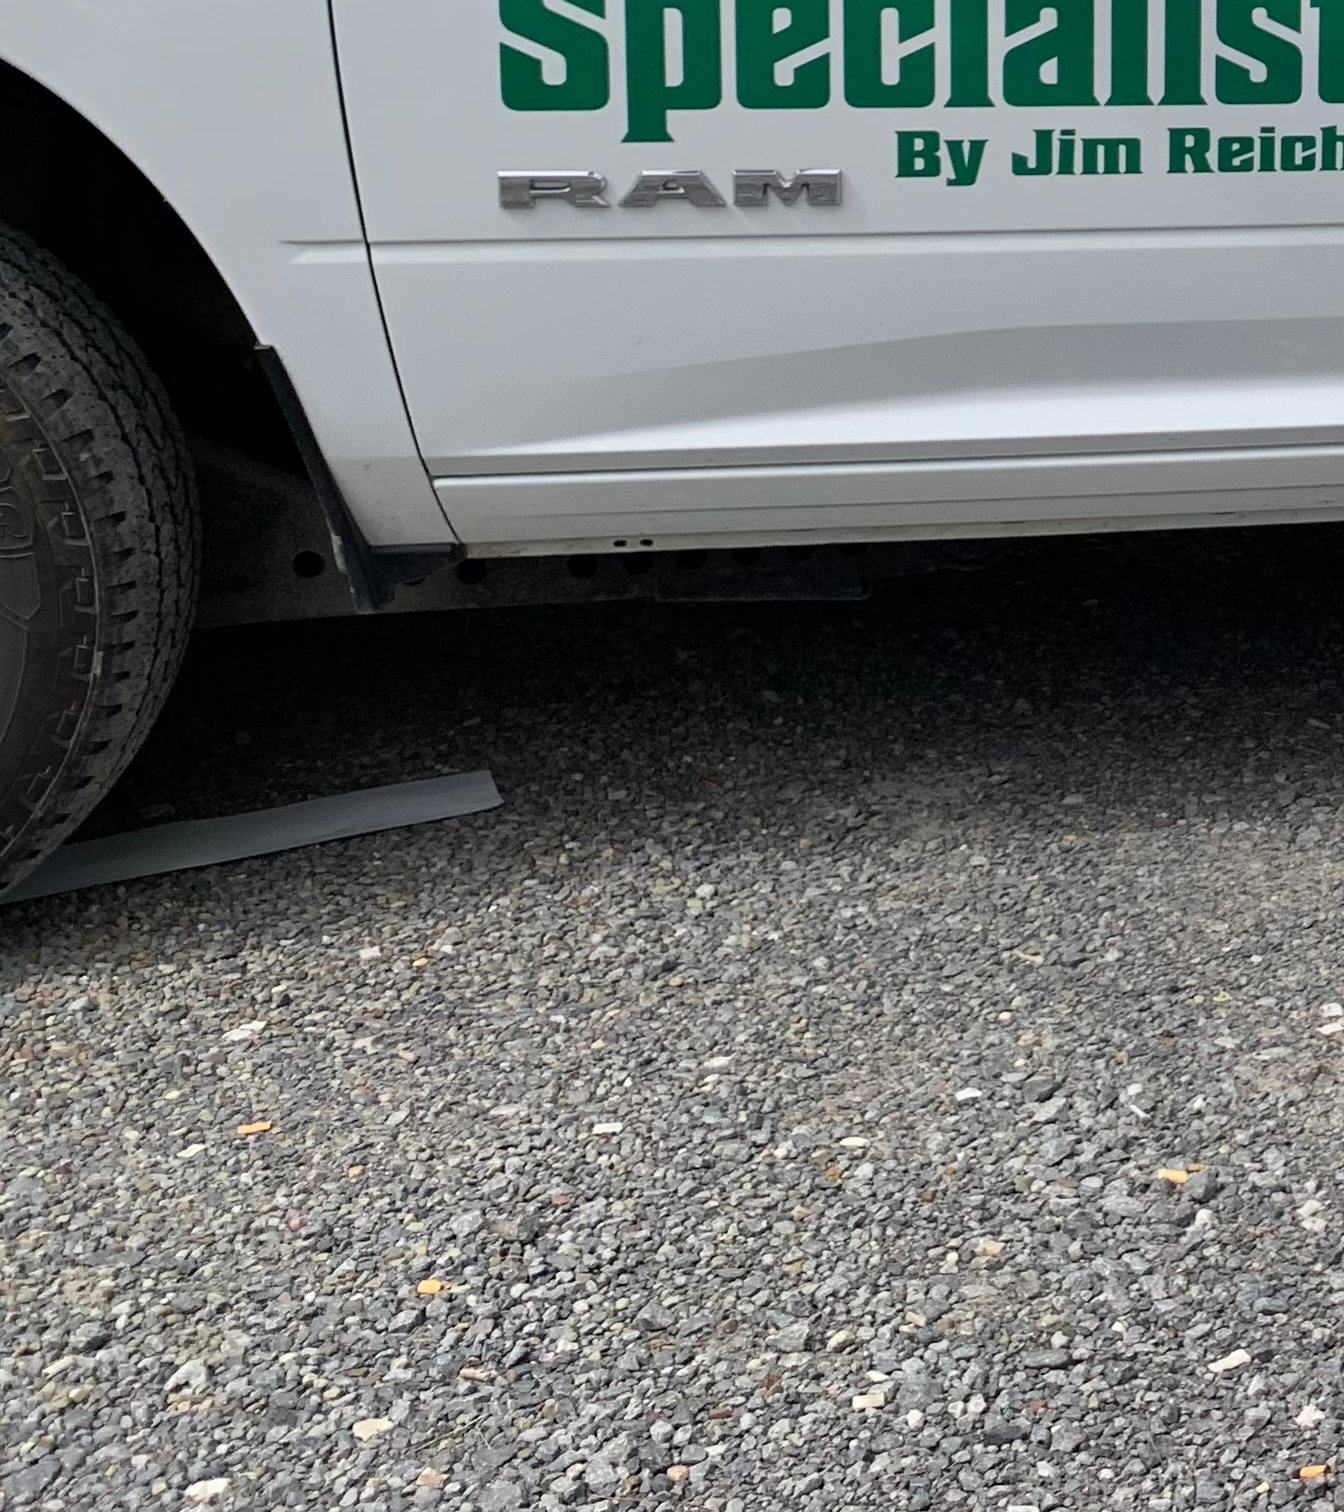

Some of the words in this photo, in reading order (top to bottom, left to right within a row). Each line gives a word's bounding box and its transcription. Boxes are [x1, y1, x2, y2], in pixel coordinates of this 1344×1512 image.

[895, 130, 989, 187] By
[1011, 129, 1144, 176] Jim
[497, 168, 844, 209] RAM
